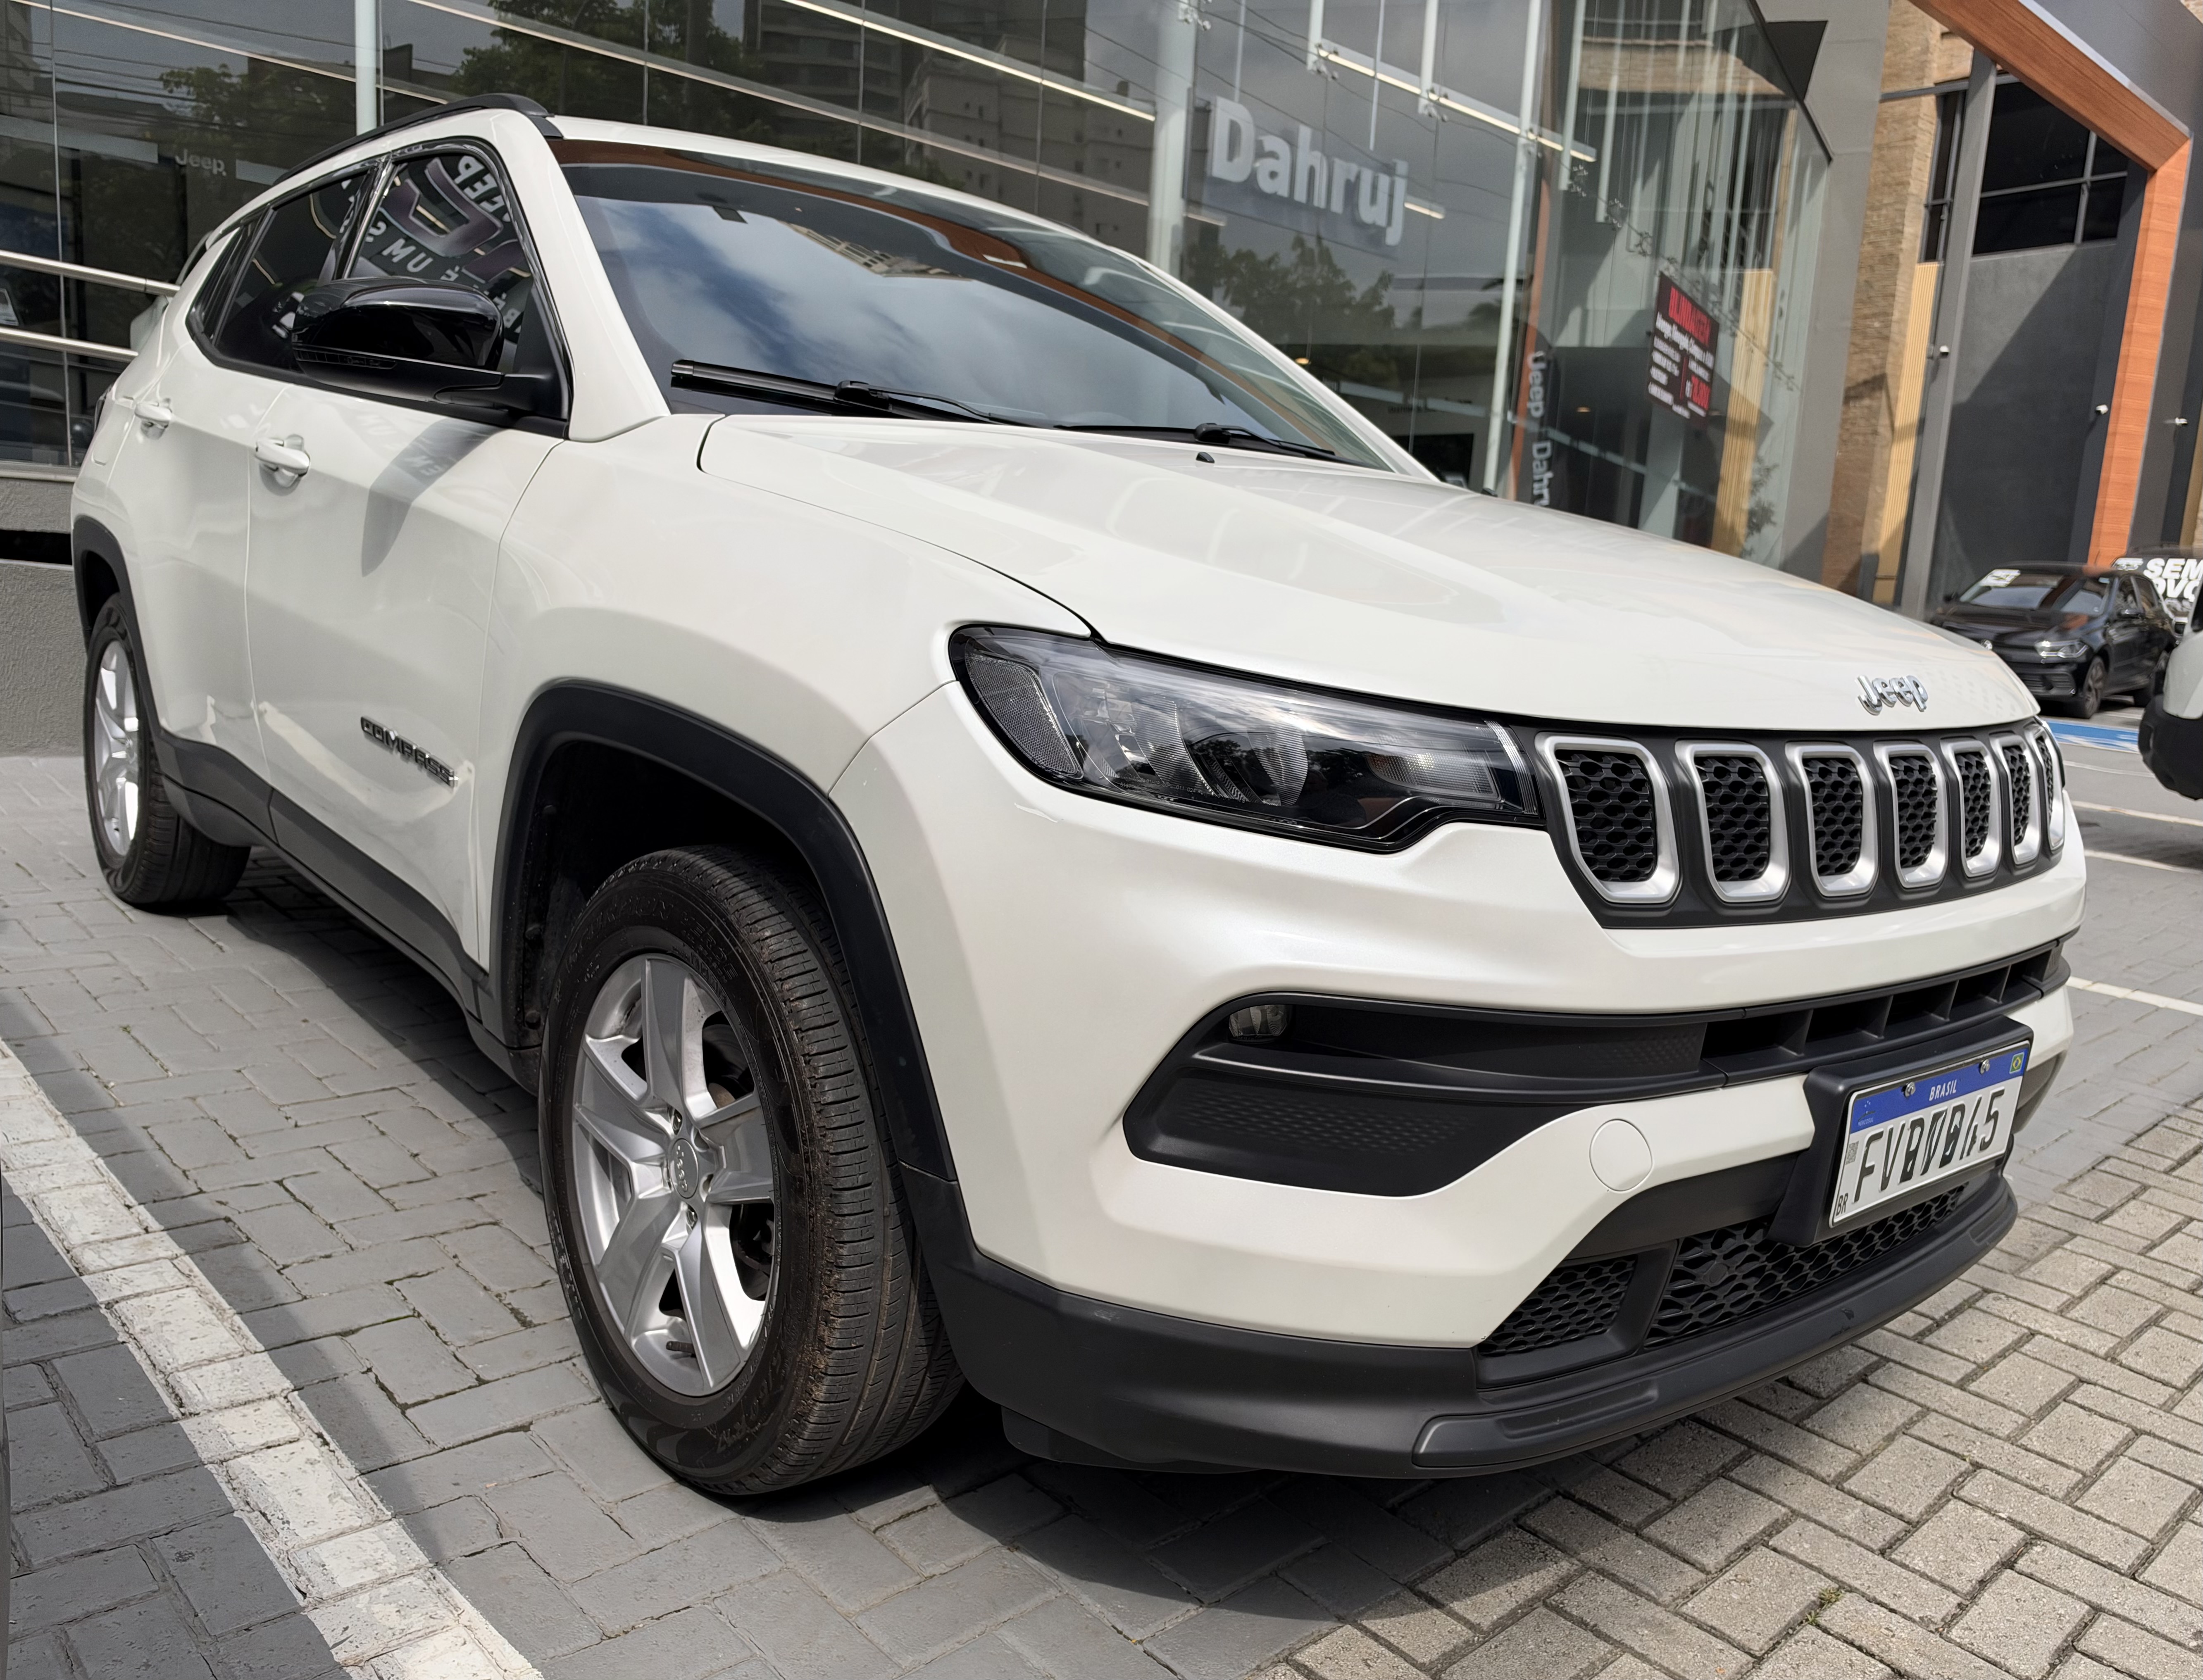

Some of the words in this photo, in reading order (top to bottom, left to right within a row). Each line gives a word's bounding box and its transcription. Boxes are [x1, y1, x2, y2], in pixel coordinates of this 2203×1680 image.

[1211, 96, 1408, 246] Dahruj
[1527, 350, 1546, 418] Jeep
[1857, 675, 1929, 716] Jeep
[360, 716, 455, 788] COMPASS
[1929, 1079, 1957, 1101] BRASIL
[1836, 1192, 1849, 1216] BR
